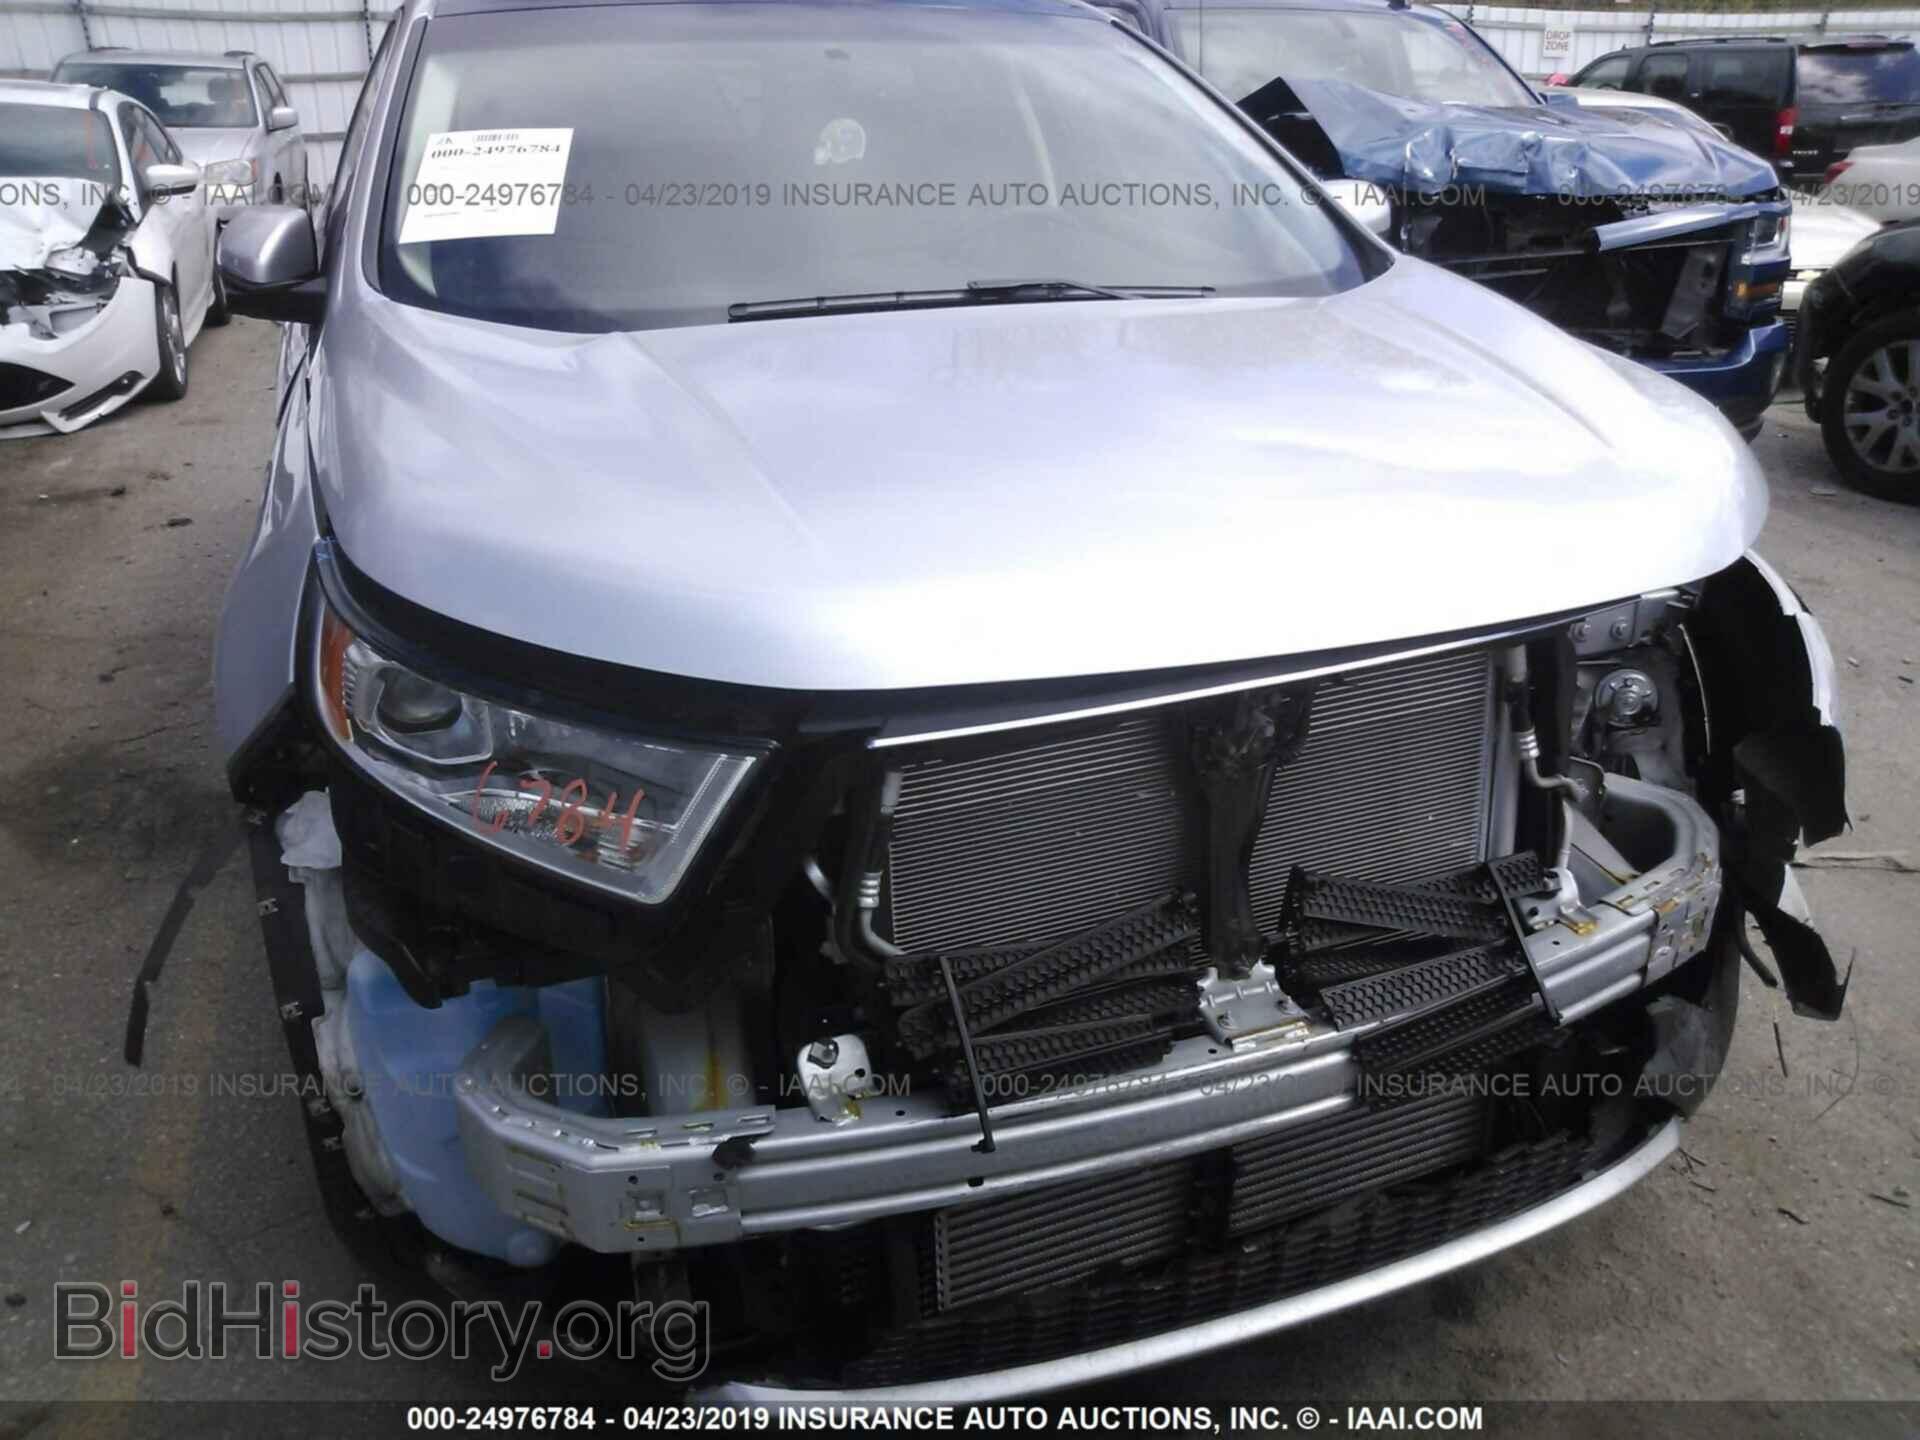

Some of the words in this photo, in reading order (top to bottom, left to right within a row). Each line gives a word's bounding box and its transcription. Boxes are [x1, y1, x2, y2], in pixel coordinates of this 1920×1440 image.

[1546, 31, 1569, 40] DROP
[1546, 41, 1569, 50] ZONE
[431, 144, 561, 159] 000-24976784
[471, 760, 645, 853] 6784
